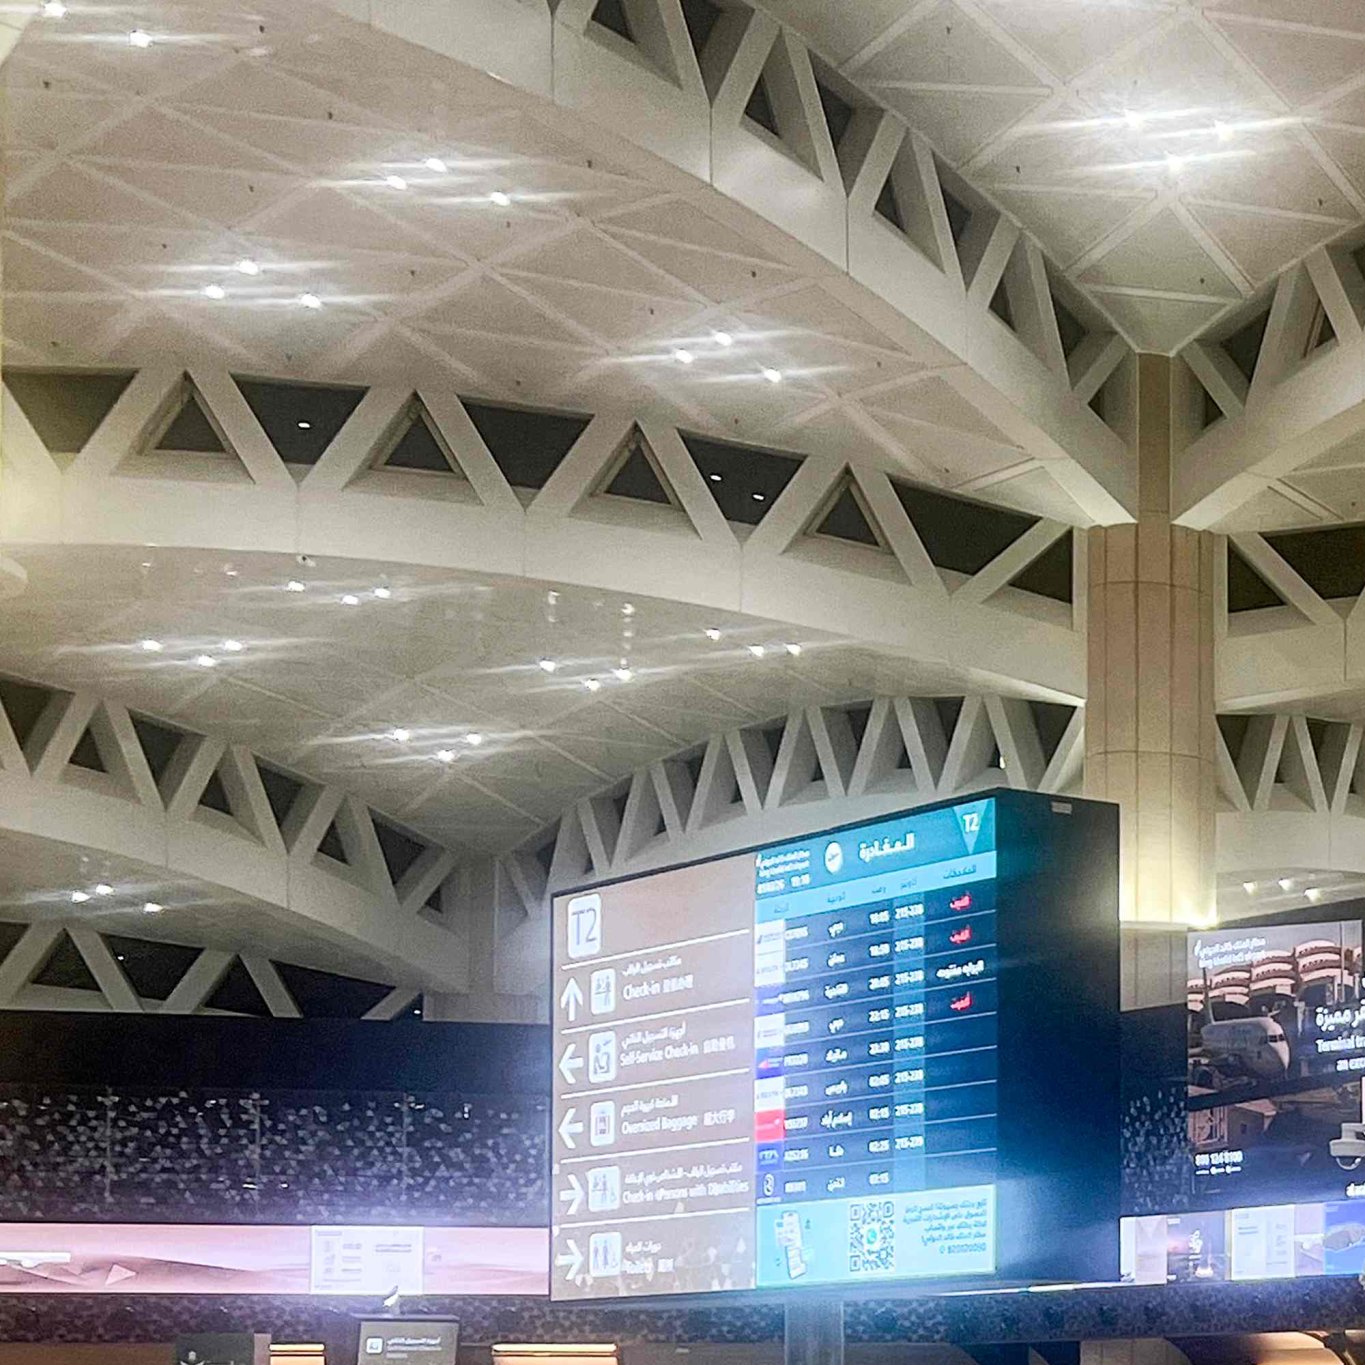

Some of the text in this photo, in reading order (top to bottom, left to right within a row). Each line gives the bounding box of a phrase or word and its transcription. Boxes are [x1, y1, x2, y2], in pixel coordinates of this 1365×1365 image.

[963, 813, 980, 833] T2
[859, 833, 915, 863] المغادرة
[571, 908, 598, 946] T2
